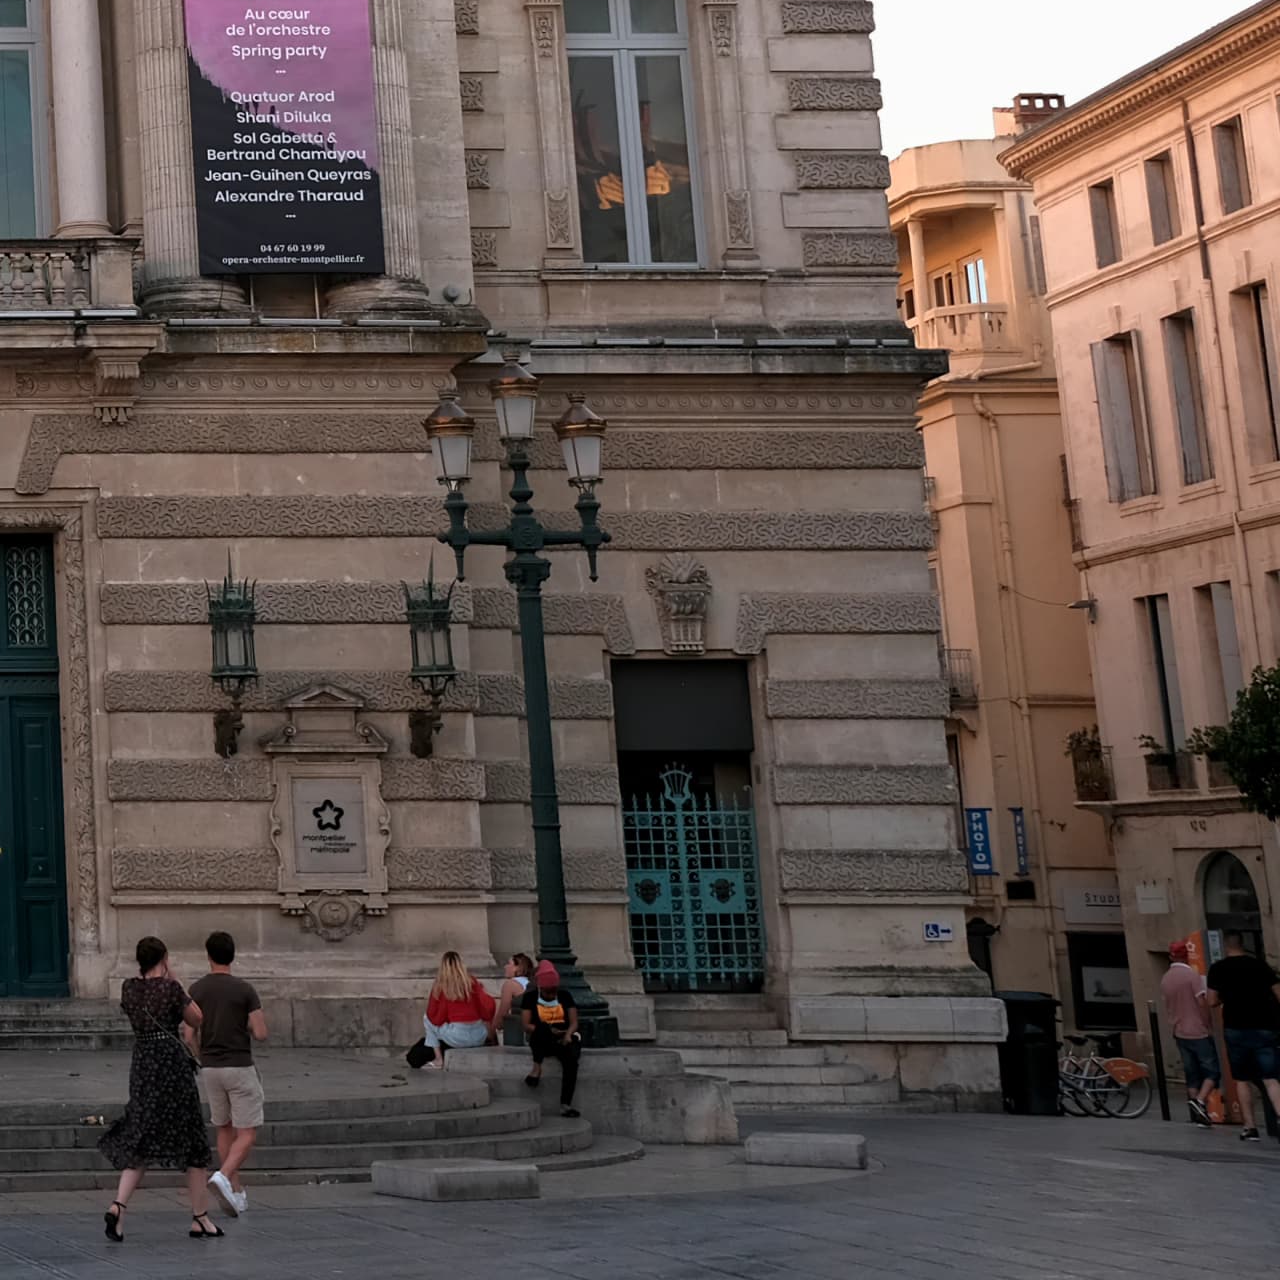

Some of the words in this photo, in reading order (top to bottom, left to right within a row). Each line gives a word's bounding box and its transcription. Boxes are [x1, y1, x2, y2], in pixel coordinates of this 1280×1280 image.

[244, 8, 265, 20] Au
[268, 10, 311, 20] cœur
[226, 24, 245, 36] de
[248, 23, 331, 36] l'orchestre
[232, 45, 282, 60] Spring
[285, 46, 327, 60] party
[230, 91, 295, 105] Quatuor
[298, 90, 335, 103] Arod
[236, 111, 280, 124] Shani
[283, 111, 332, 123] Diluka
[233, 132, 256, 144] Sol
[259, 131, 324, 144] Gabetta
[327, 132, 338, 144] &
[207, 148, 276, 161] Bertrand
[279, 148, 367, 163] Chamayou
[204, 169, 305, 182] Jean-Guihen
[307, 169, 372, 184] Queyras
[215, 190, 295, 203] Alexandre
[297, 189, 365, 202] Tharaud
[260, 244, 272, 253] 04
[273, 244, 285, 253] 67
[287, 244, 299, 253] 60
[301, 244, 313, 253] 19
[313, 244, 326, 253] 99
[222, 255, 365, 266] opera-orchestre-montpellier.fr
[971, 812, 987, 862] PHOTO
